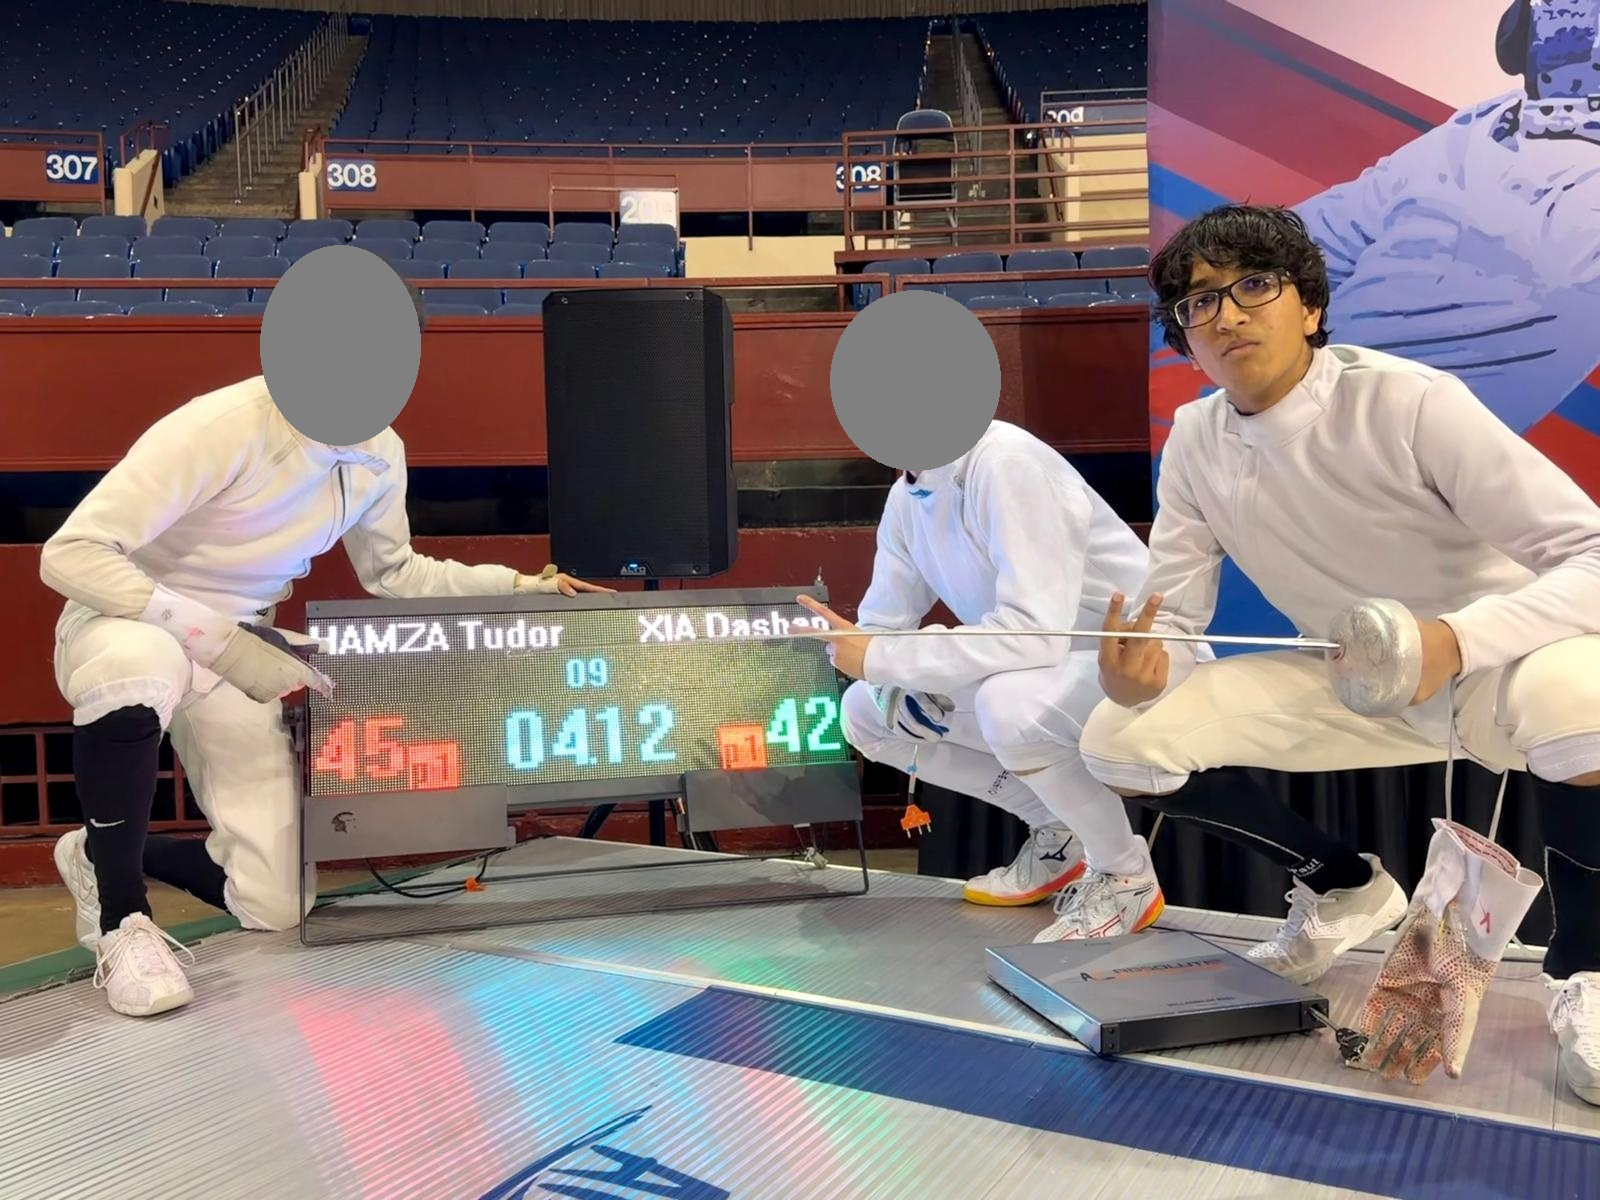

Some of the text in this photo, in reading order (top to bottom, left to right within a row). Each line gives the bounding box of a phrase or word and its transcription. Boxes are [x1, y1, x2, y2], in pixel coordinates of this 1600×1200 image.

[46, 154, 98, 180] 307
[327, 163, 377, 188] 308
[836, 165, 882, 189] 308
[309, 619, 564, 655] HAMZA Tudor
[638, 614, 696, 642] XIA
[566, 657, 607, 687] 09
[767, 696, 841, 752] 42
[315, 716, 405, 780] 45
